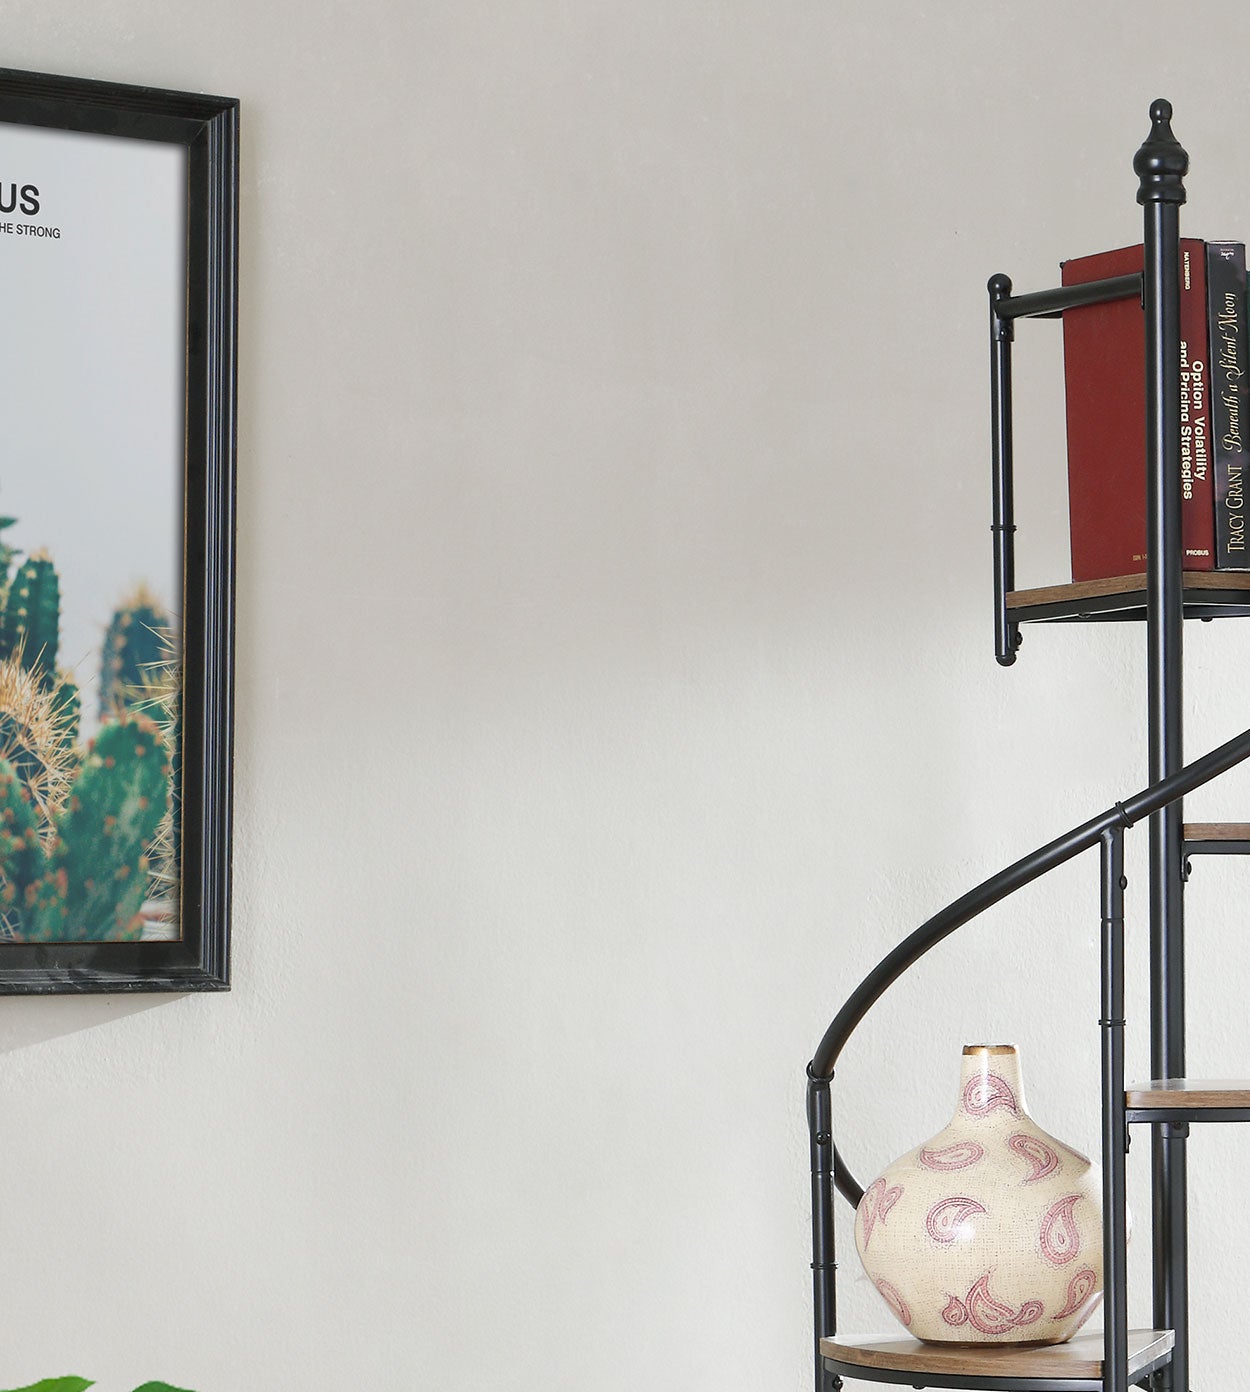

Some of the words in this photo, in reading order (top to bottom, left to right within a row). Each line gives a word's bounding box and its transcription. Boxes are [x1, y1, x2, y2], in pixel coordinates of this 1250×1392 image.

[16, 223, 61, 239] STRONG
[1218, 292, 1239, 333] Moon
[1180, 340, 1190, 368] and
[1219, 332, 1246, 381] Silent
[1190, 360, 1204, 410] Option
[1228, 384, 1239, 392] a
[1221, 390, 1243, 453] Beneath
[1181, 426, 1195, 500] Strategies
[1194, 416, 1208, 481] Volatility
[1225, 464, 1244, 509] GRANT
[1227, 512, 1246, 554] TRACY
